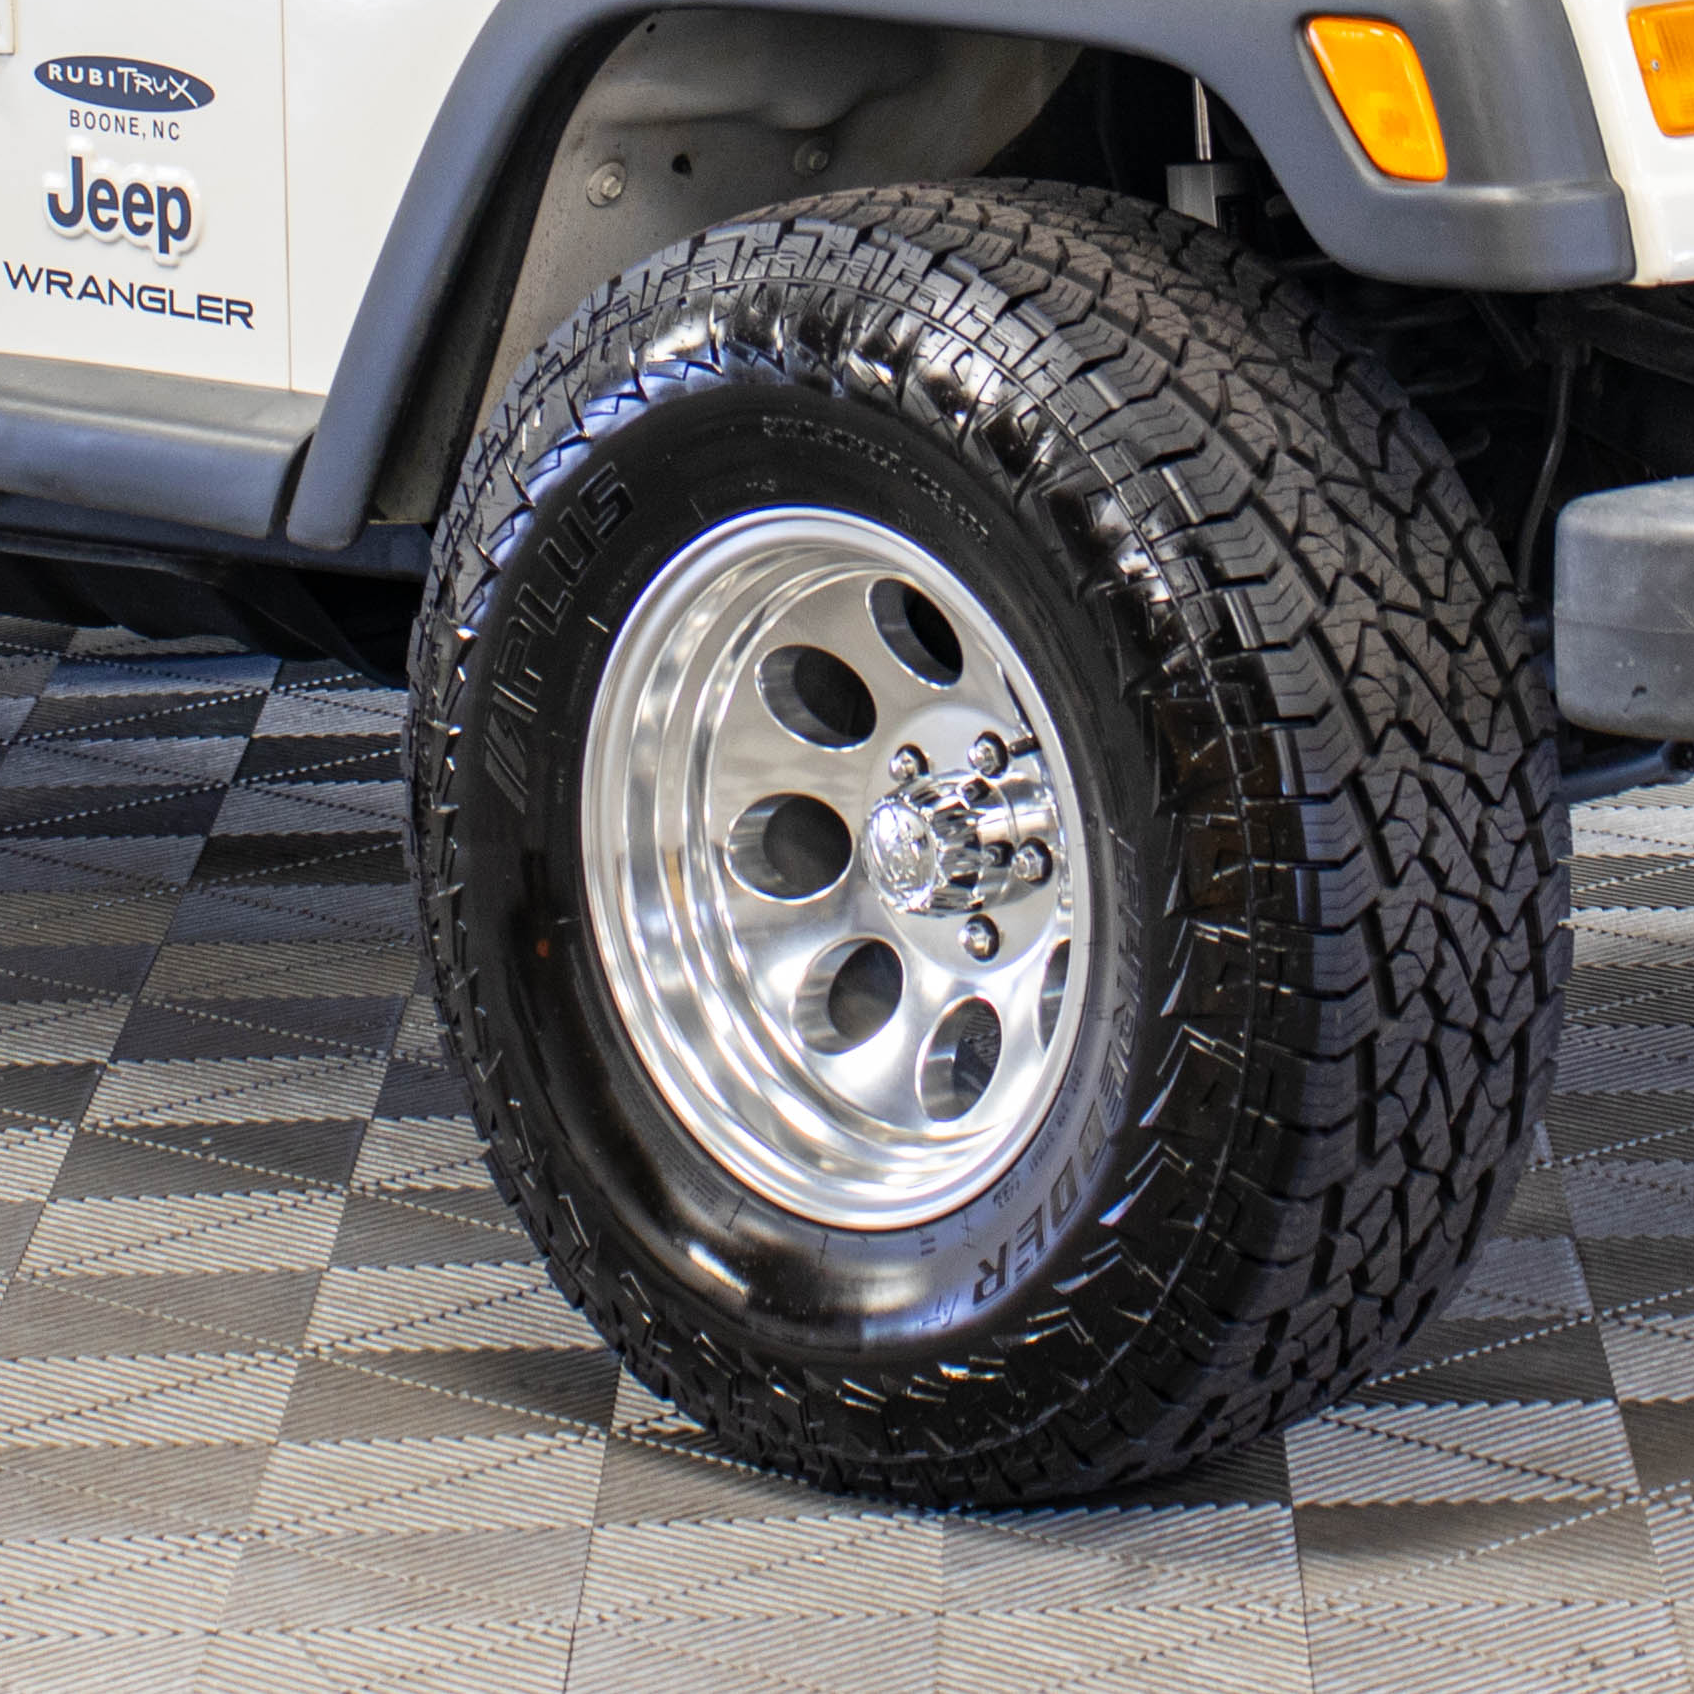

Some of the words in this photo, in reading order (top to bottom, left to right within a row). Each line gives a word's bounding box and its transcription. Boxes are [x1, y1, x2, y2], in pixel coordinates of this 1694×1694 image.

[68, 109, 148, 142] BOONE,
[152, 120, 182, 142] NC
[46, 155, 193, 256] Jeep
[2, 260, 256, 331] WRANGLER
